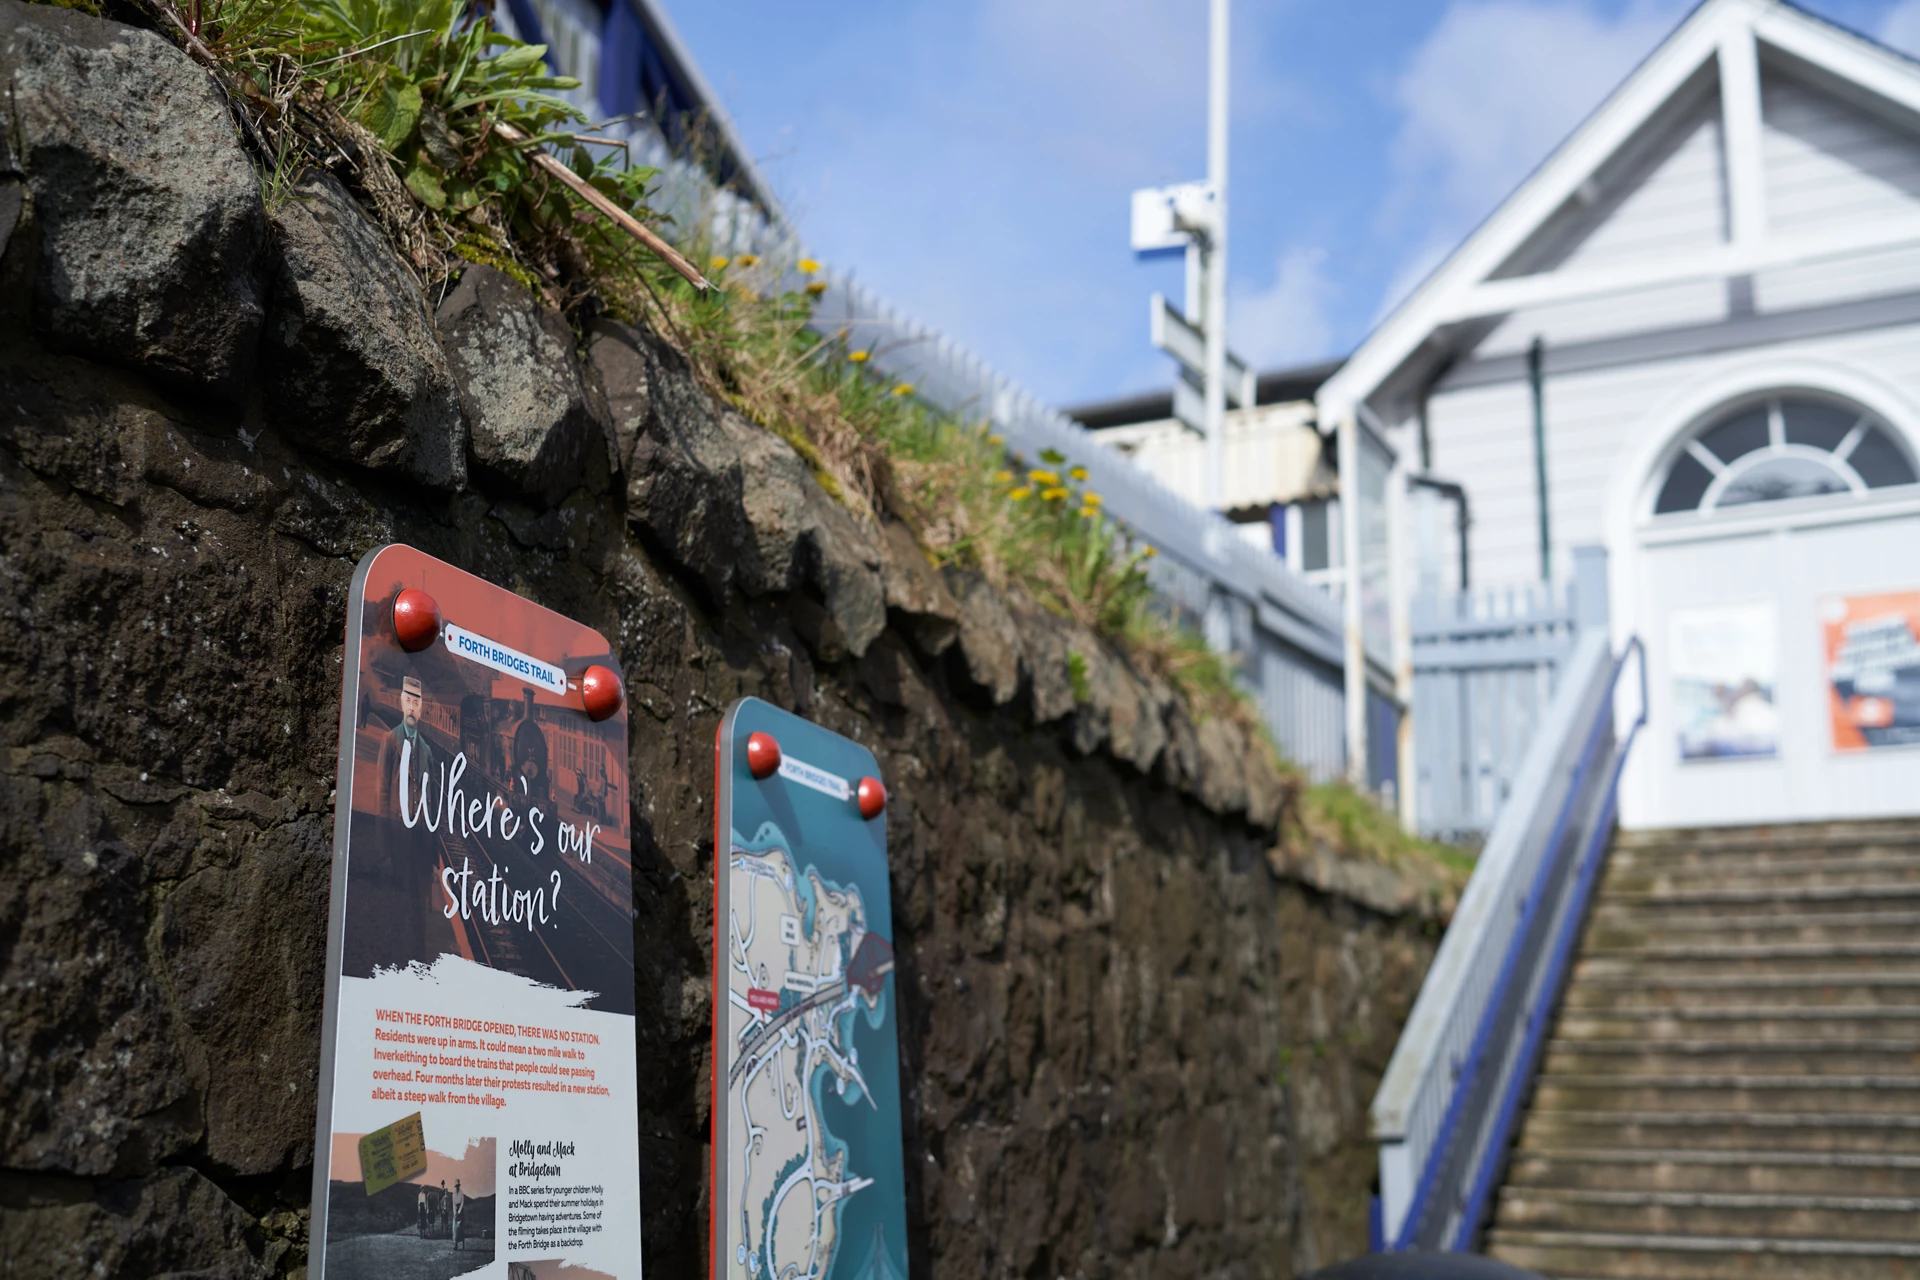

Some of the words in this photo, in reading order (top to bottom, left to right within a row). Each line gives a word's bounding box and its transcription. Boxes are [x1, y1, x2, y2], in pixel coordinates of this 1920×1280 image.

[459, 636, 490, 658] FORTH
[493, 649, 529, 674] BRIDGES
[531, 665, 555, 684] TRAIL
[399, 739, 544, 854] Where's
[558, 822, 600, 864] our
[442, 857, 561, 931] station?
[376, 1009, 403, 1023] WHEN
[405, 1012, 421, 1025] THE
[424, 1015, 451, 1028] FORTH
[453, 1018, 481, 1031] BRIDGE
[484, 1022, 516, 1037] OPENED,
[518, 1026, 541, 1038] THERE
[542, 1028, 558, 1040] WAS
[560, 1031, 570, 1041] NO
[571, 1032, 600, 1045] STATION.
[375, 1028, 415, 1043] Residents
[417, 1036, 436, 1045] were
[438, 1038, 447, 1049] up
[450, 1036, 456, 1047] in
[458, 1040, 478, 1049] arms.
[480, 1039, 485, 1050] It
[487, 1041, 506, 1052] could
[508, 1044, 526, 1054] mean
[528, 1046, 532, 1055] a
[533, 1046, 546, 1056] two
[548, 1046, 560, 1057] mile
[562, 1048, 576, 1059] walk
[578, 1051, 584, 1060] to
[374, 1048, 427, 1067] Inverkeithing
[429, 1054, 437, 1064] to
[440, 1054, 461, 1066] board
[464, 1056, 475, 1067] the
[477, 1058, 497, 1069] trains
[499, 1059, 513, 1070] that
[516, 1062, 538, 1074] people
[540, 1063, 557, 1074] could
[559, 1067, 569, 1075] see
[571, 1067, 594, 1080] passing
[373, 1069, 413, 1081] overhead.
[416, 1071, 433, 1083] Four
[435, 1074, 464, 1085] months
[466, 1074, 482, 1086] later
[484, 1076, 500, 1087] their
[502, 1080, 530, 1091] protests
[532, 1080, 559, 1092] resulted
[561, 1082, 566, 1092] in
[573, 1085, 585, 1094] new
[587, 1085, 609, 1097] station,
[372, 1087, 395, 1100] albeit
[398, 1092, 402, 1100] a
[404, 1090, 426, 1105] steep
[428, 1091, 446, 1103] walk
[448, 1092, 466, 1104] from
[468, 1093, 479, 1104] the
[481, 1094, 506, 1109] village.
[509, 1140, 534, 1159] Molly
[537, 1141, 551, 1155] and
[553, 1141, 575, 1159] Mack
[509, 1164, 517, 1178] at
[519, 1162, 560, 1181] Bridgetown
[509, 1186, 513, 1194] In
[519, 1186, 530, 1194] BBC
[531, 1186, 544, 1194] series
[553, 1187, 572, 1196] younger
[573, 1185, 590, 1193] children
[592, 1185, 603, 1195] Molly
[509, 1200, 518, 1208] and
[520, 1200, 533, 1208] Mack
[534, 1200, 548, 1209] spend
[549, 1199, 560, 1207] their
[581, 1199, 598, 1208] holidays
[509, 1213, 538, 1224] Bridgetown
[539, 1213, 554, 1223] having
[583, 1211, 596, 1219] Some
[597, 1211, 602, 1219] of
[509, 1228, 517, 1236] the
[518, 1227, 535, 1237] filming
[536, 1226, 549, 1235] takes
[550, 1225, 562, 1236] place
[563, 1225, 567, 1233] in
[568, 1225, 576, 1233] the
[577, 1224, 591, 1235] village
[592, 1224, 602, 1232] with
[508, 1241, 517, 1250] the
[518, 1240, 532, 1249] Forth
[533, 1239, 549, 1250] Bridge
